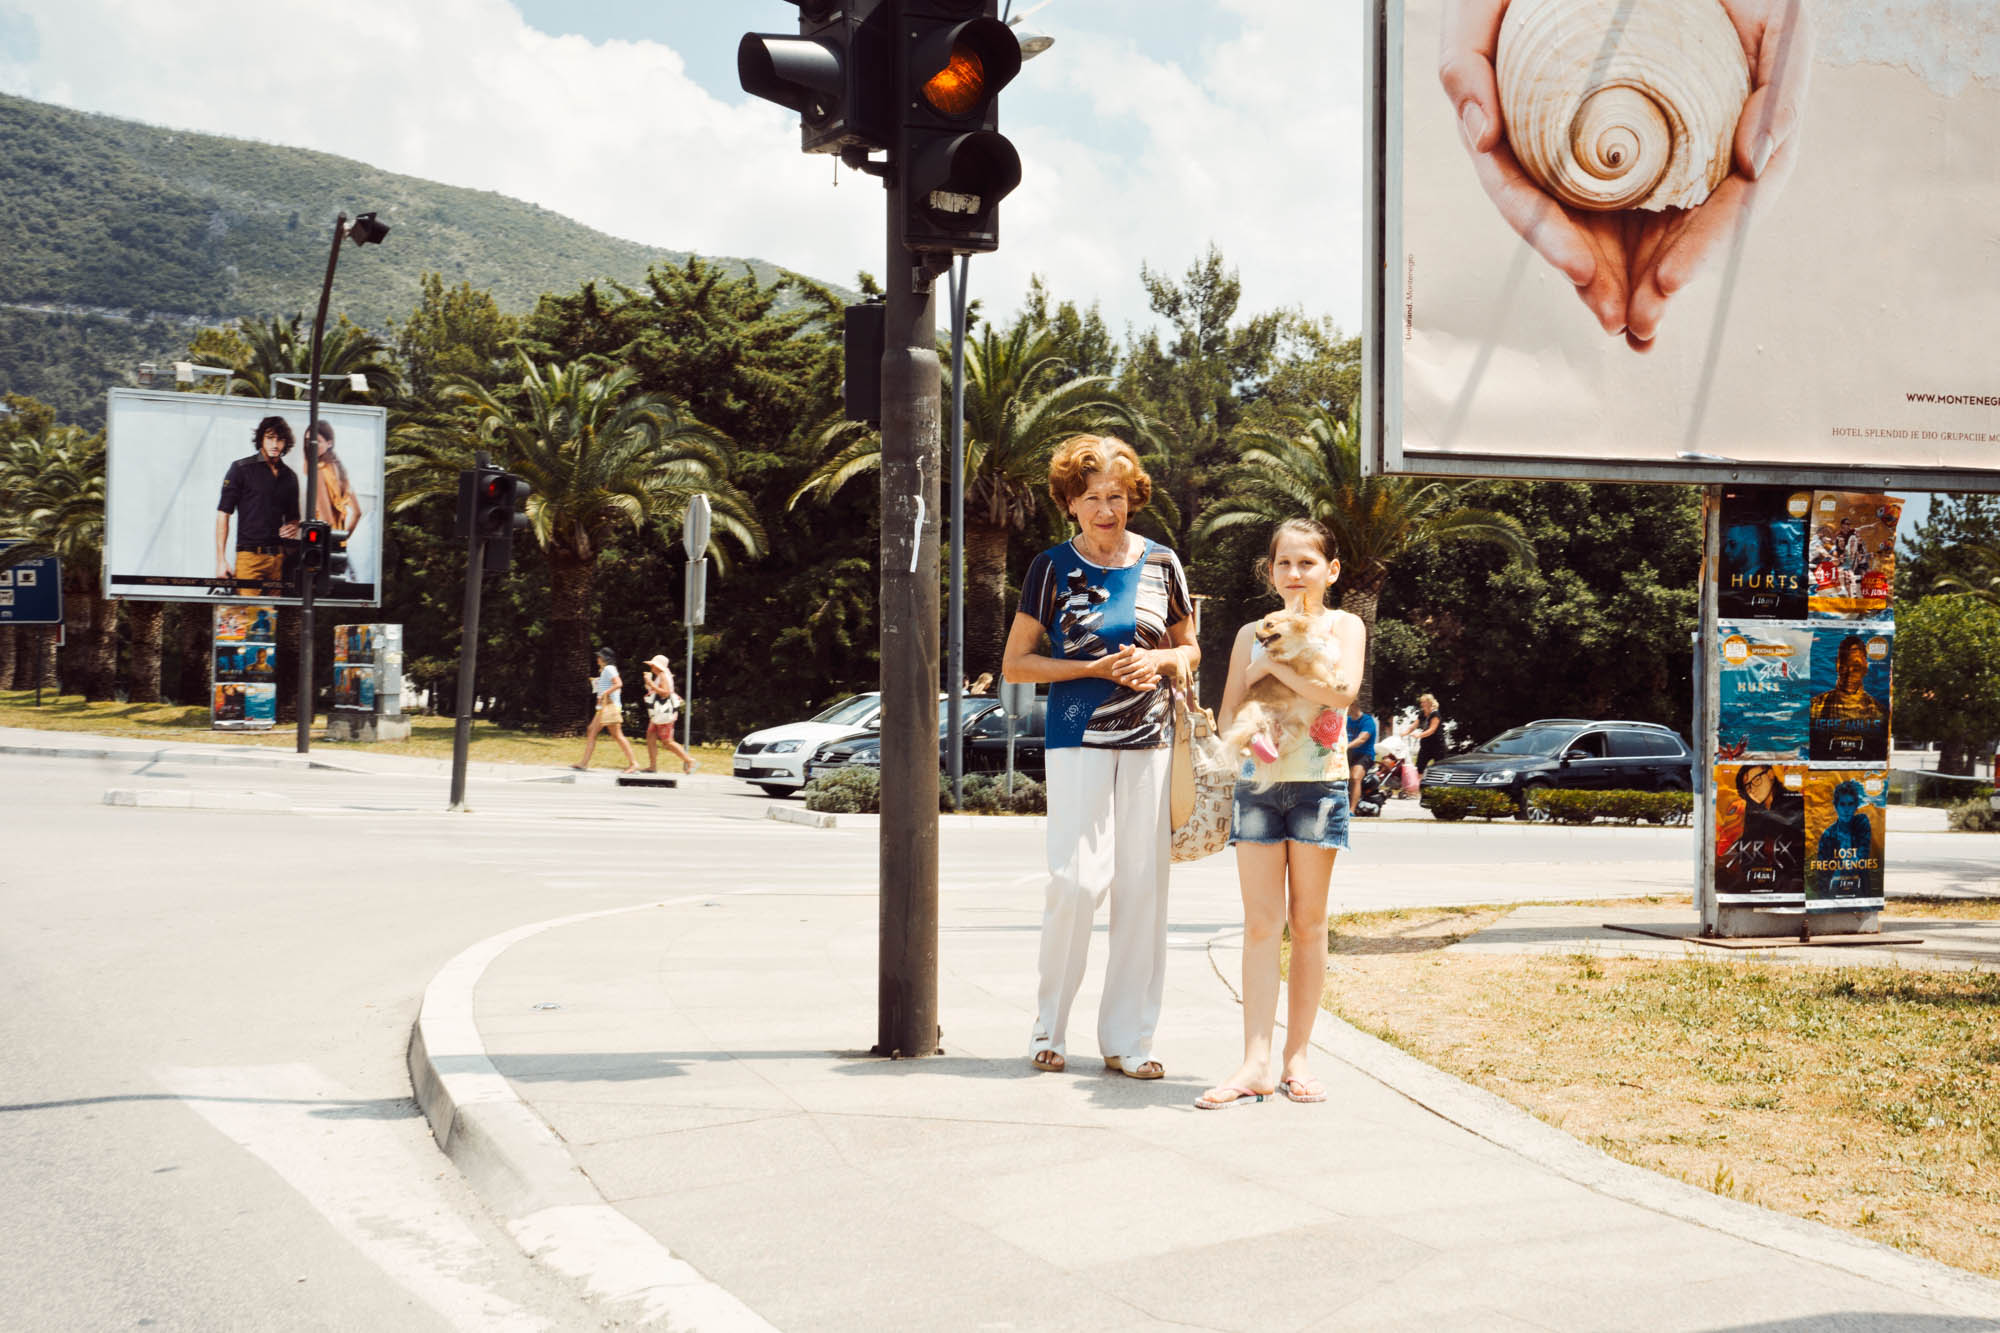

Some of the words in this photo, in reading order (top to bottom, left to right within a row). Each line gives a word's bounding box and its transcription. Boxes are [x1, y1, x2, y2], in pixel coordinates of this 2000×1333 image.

[1832, 427, 1862, 438] HOTEL
[1864, 429, 1908, 440] SPLENDID
[1910, 431, 1919, 440] JE
[1922, 431, 1938, 441] DIO
[1731, 574, 1799, 589] HURTS
[1737, 682, 1780, 692] HURTS
[1833, 847, 1858, 859] LOST
[1809, 858, 1879, 871] FREQUENCIES
